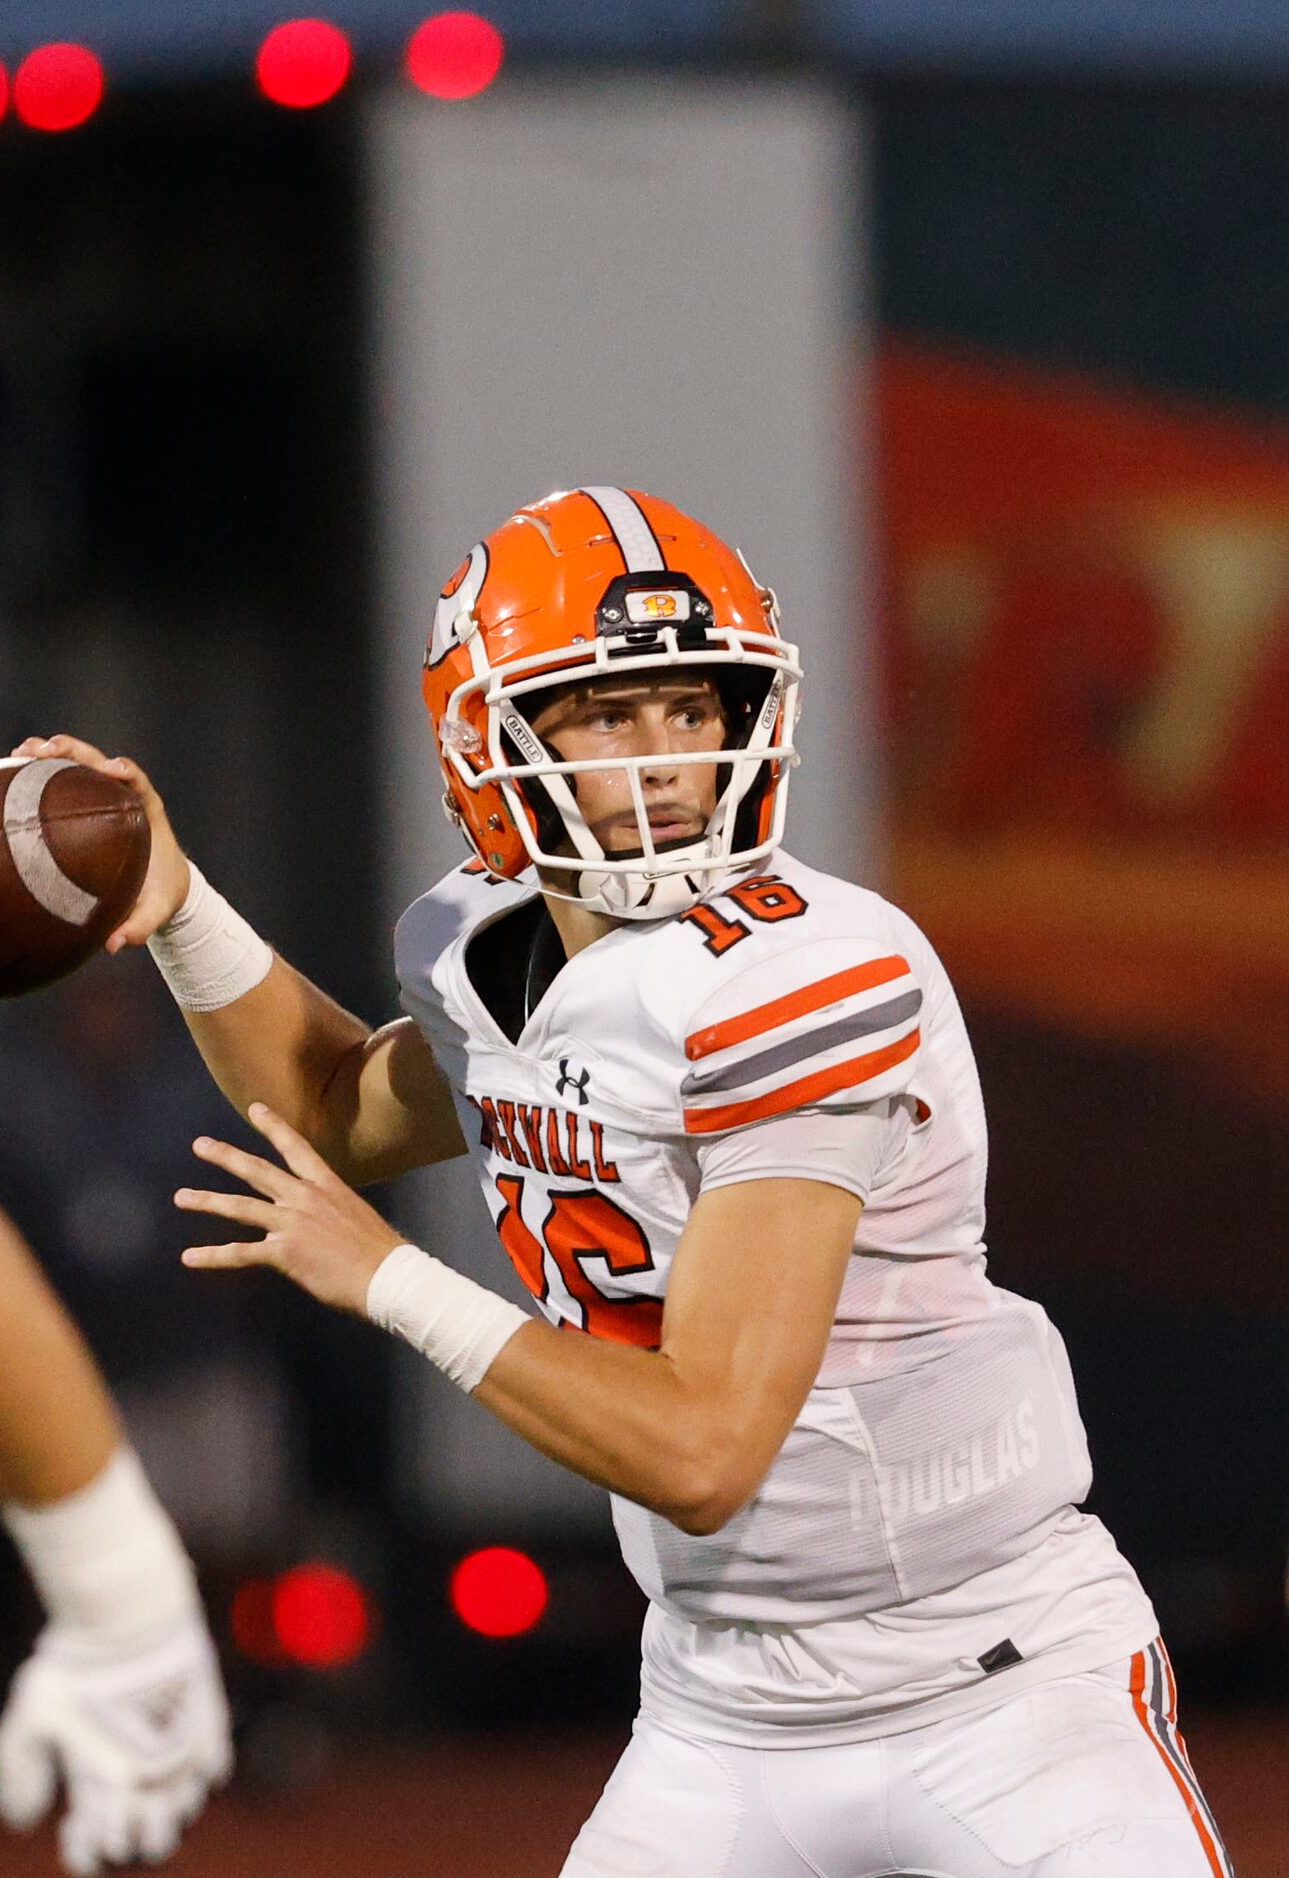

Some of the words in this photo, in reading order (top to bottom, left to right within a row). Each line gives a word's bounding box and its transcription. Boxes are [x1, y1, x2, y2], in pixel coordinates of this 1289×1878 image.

[642, 594, 677, 618] R
[509, 720, 540, 760] BATTLE
[676, 875, 809, 959] 16
[496, 1172, 664, 1352] 16
